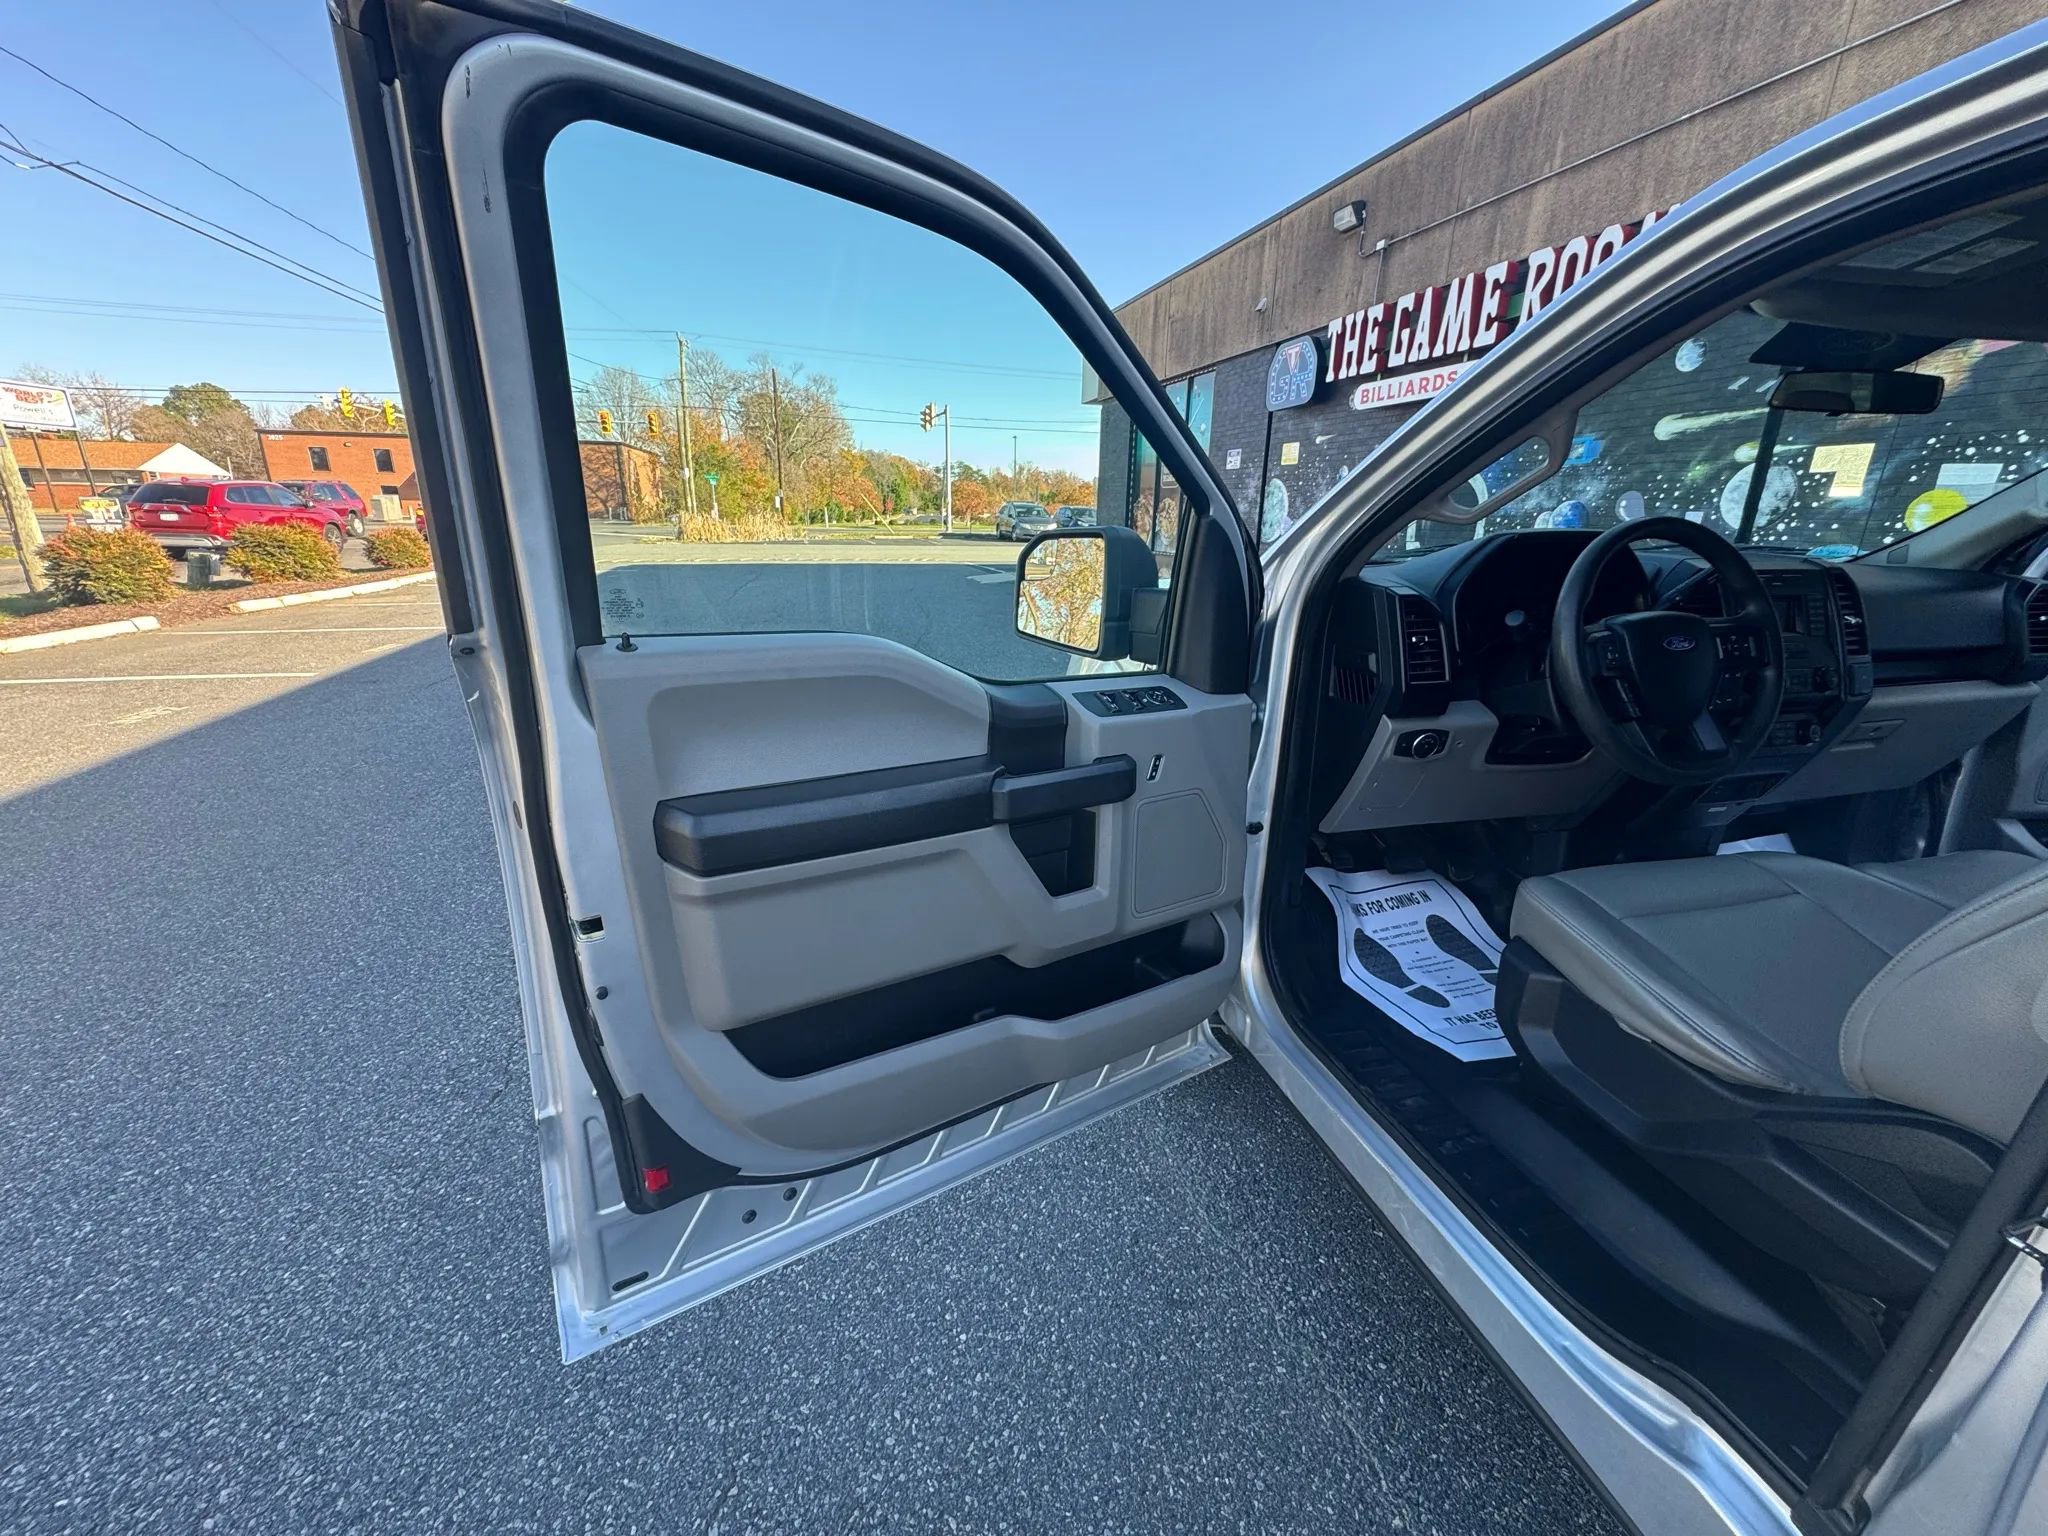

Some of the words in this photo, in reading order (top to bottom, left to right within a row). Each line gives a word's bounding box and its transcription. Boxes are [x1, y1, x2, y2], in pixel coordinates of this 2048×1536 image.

[1325, 302, 1385, 383] THE
[1387, 260, 1509, 368] GAME
[1514, 203, 1682, 332] ROO
[1359, 370, 1458, 405] BILLIARDS
[1366, 899, 1388, 915] FOR
[1384, 892, 1421, 911] COMING
[1417, 889, 1433, 903] IN
[1454, 1013, 1478, 1025] HAS
